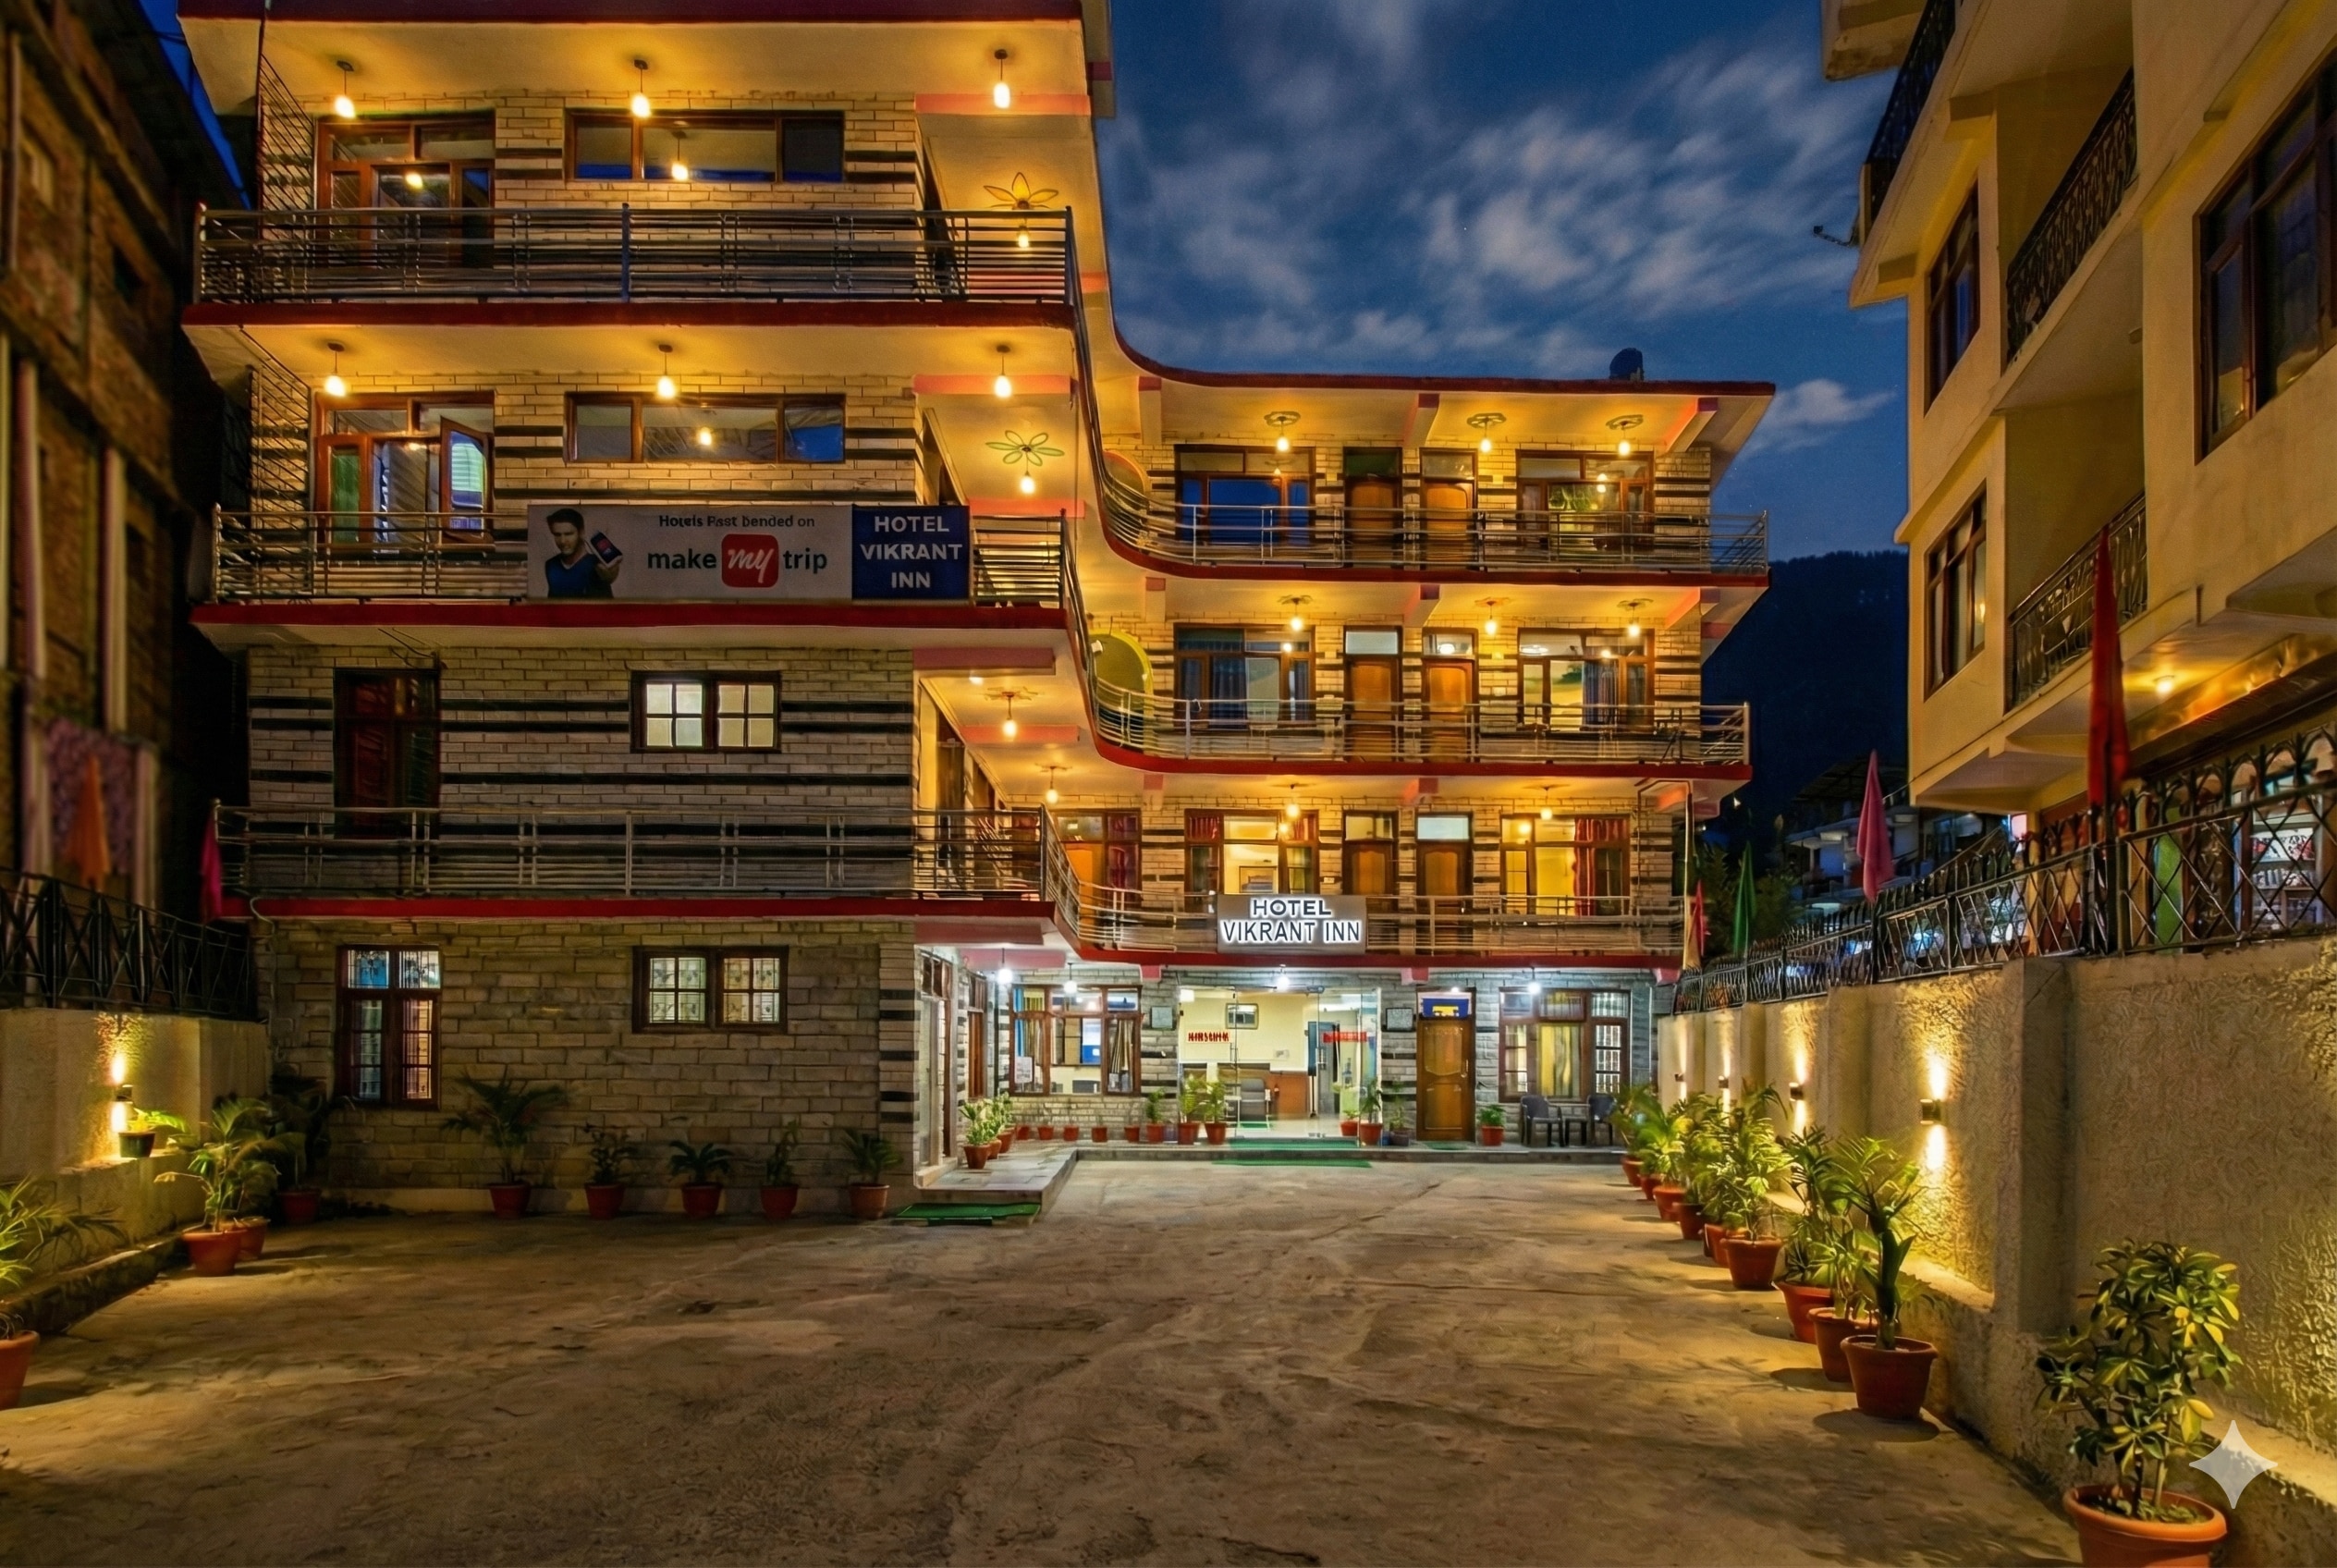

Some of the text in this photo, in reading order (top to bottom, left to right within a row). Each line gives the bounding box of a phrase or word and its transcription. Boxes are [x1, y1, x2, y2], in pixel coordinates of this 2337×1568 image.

[798, 517, 815, 527] on
[874, 516, 950, 533] HOTEL
[860, 543, 963, 560] VIKRANT
[647, 547, 828, 583] make my trip
[891, 571, 931, 589] INN
[1252, 899, 1332, 916] HOTEL
[1222, 921, 1360, 942] VIKRANT INN
